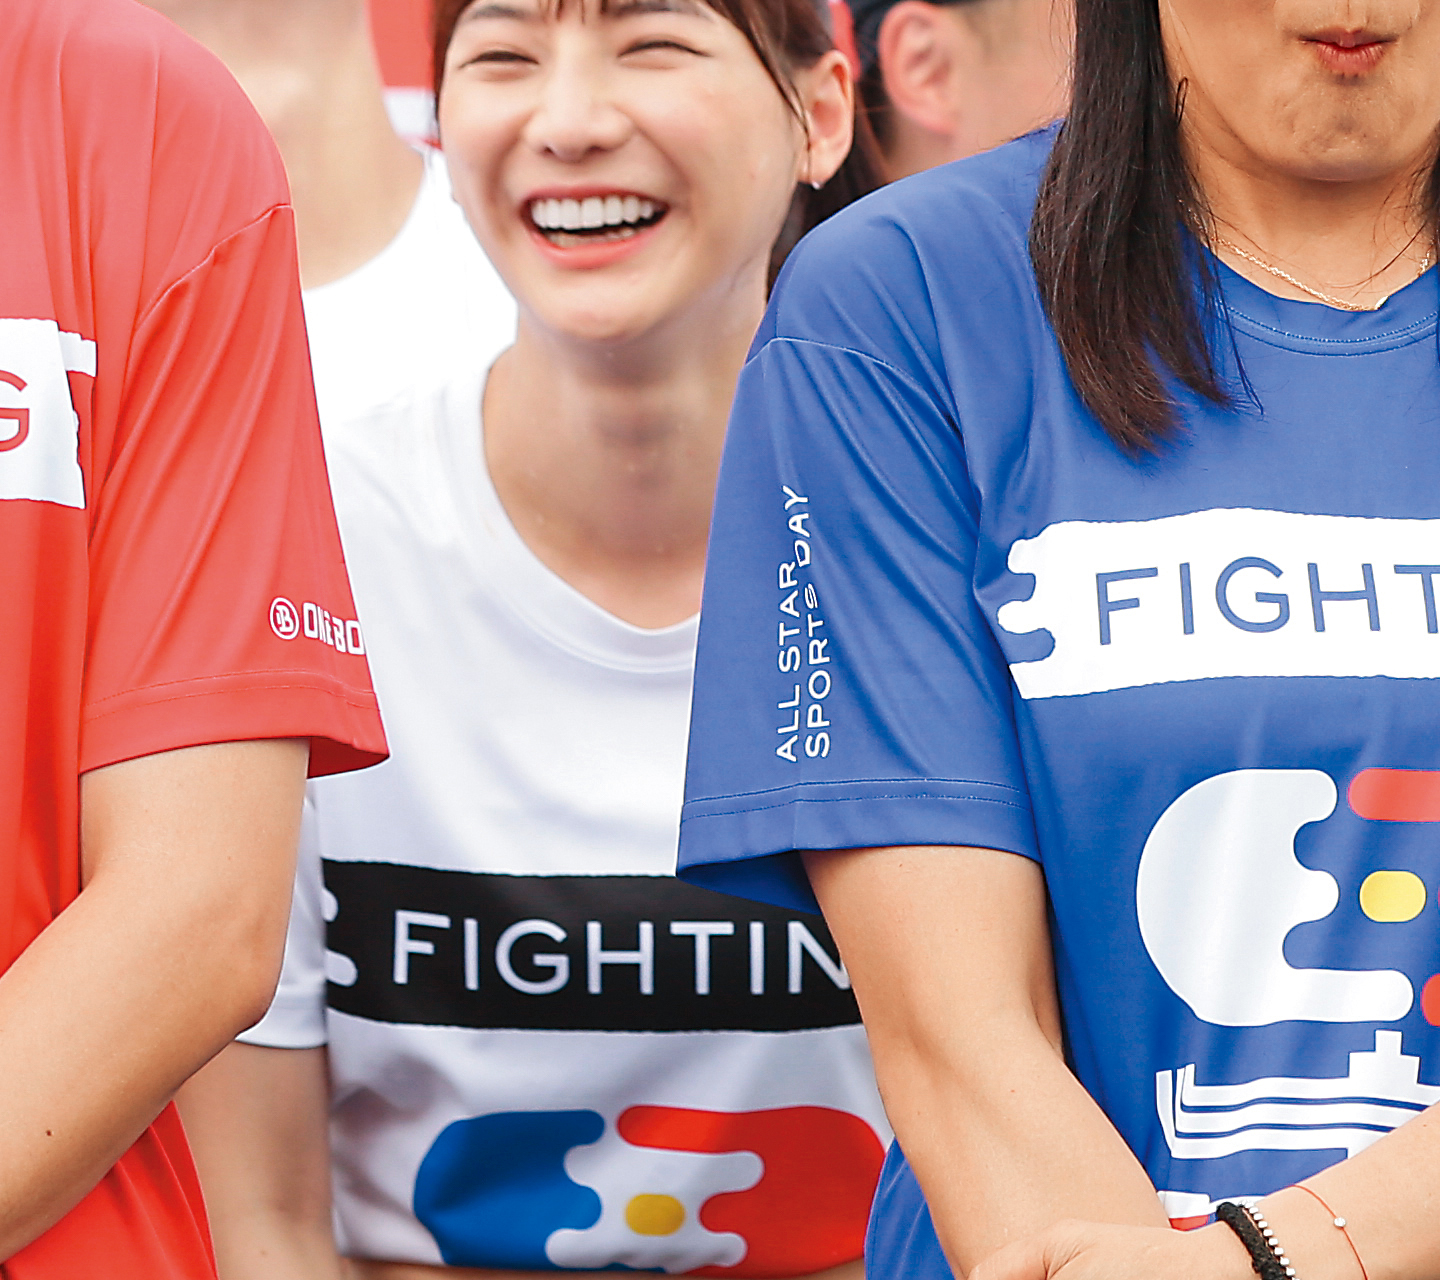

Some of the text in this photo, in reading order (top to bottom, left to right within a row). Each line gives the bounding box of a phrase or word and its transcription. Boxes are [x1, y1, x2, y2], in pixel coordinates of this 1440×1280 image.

[776, 561, 802, 763] ALL STAR
[781, 484, 832, 759] SPORTS DAY
[393, 909, 852, 995] FIGHTIN
